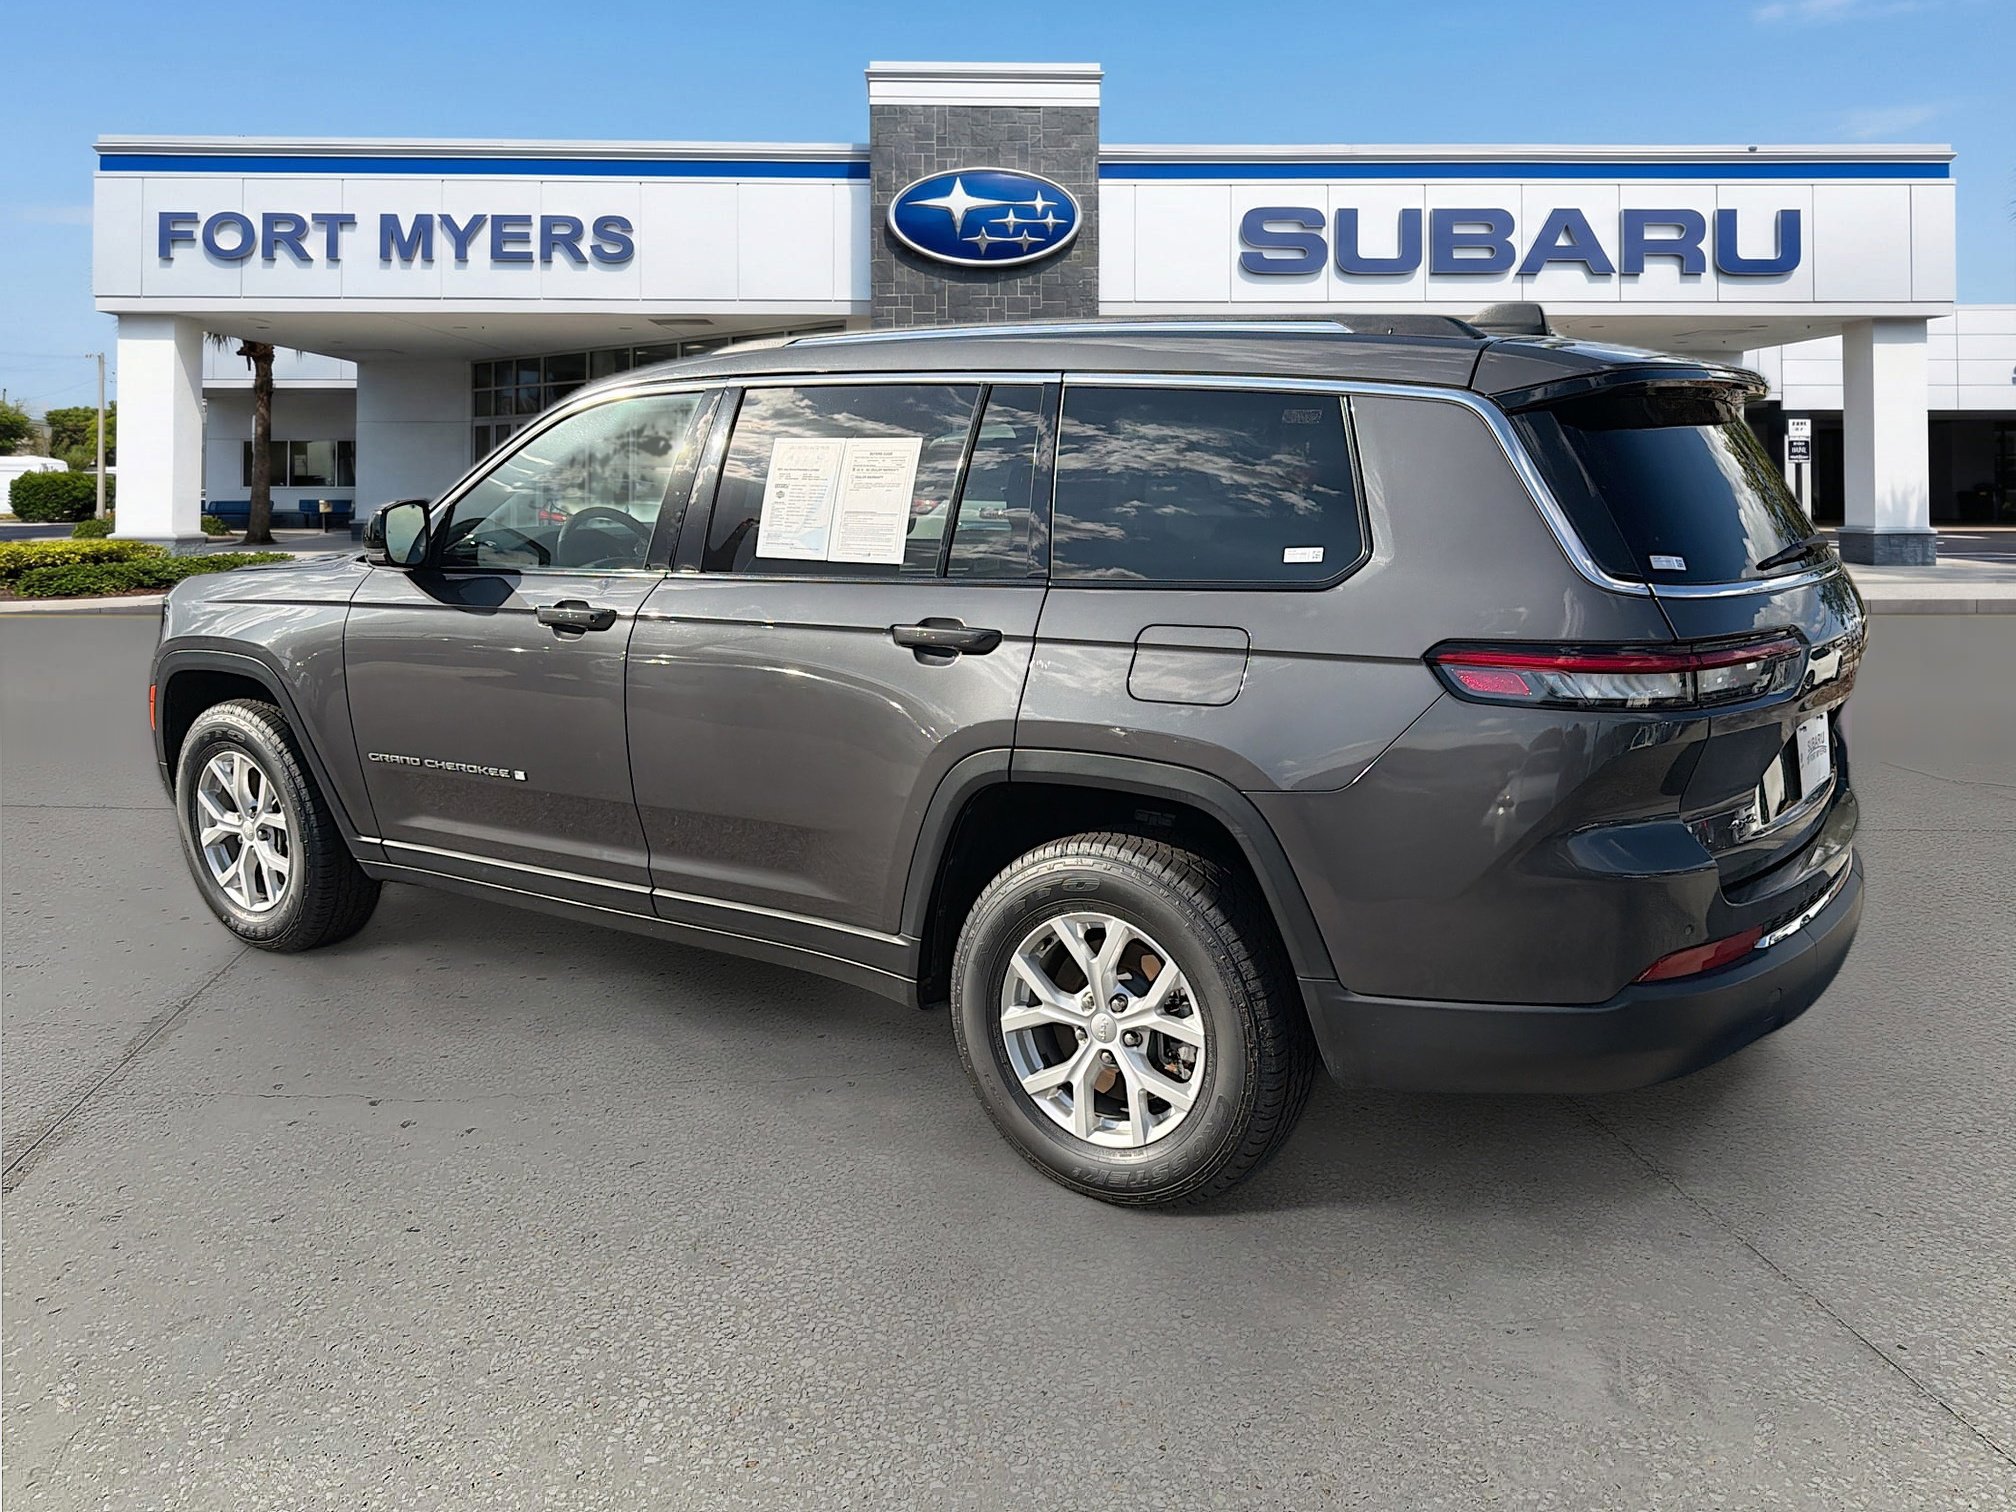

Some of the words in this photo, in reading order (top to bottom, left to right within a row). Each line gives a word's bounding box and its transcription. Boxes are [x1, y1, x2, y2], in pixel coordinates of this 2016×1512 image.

[157, 211, 357, 263] FORT
[379, 213, 636, 265] MYERS
[1239, 207, 1802, 276] SUBARU
[368, 752, 421, 766] GRAND
[424, 759, 511, 778] CHEROKEE
